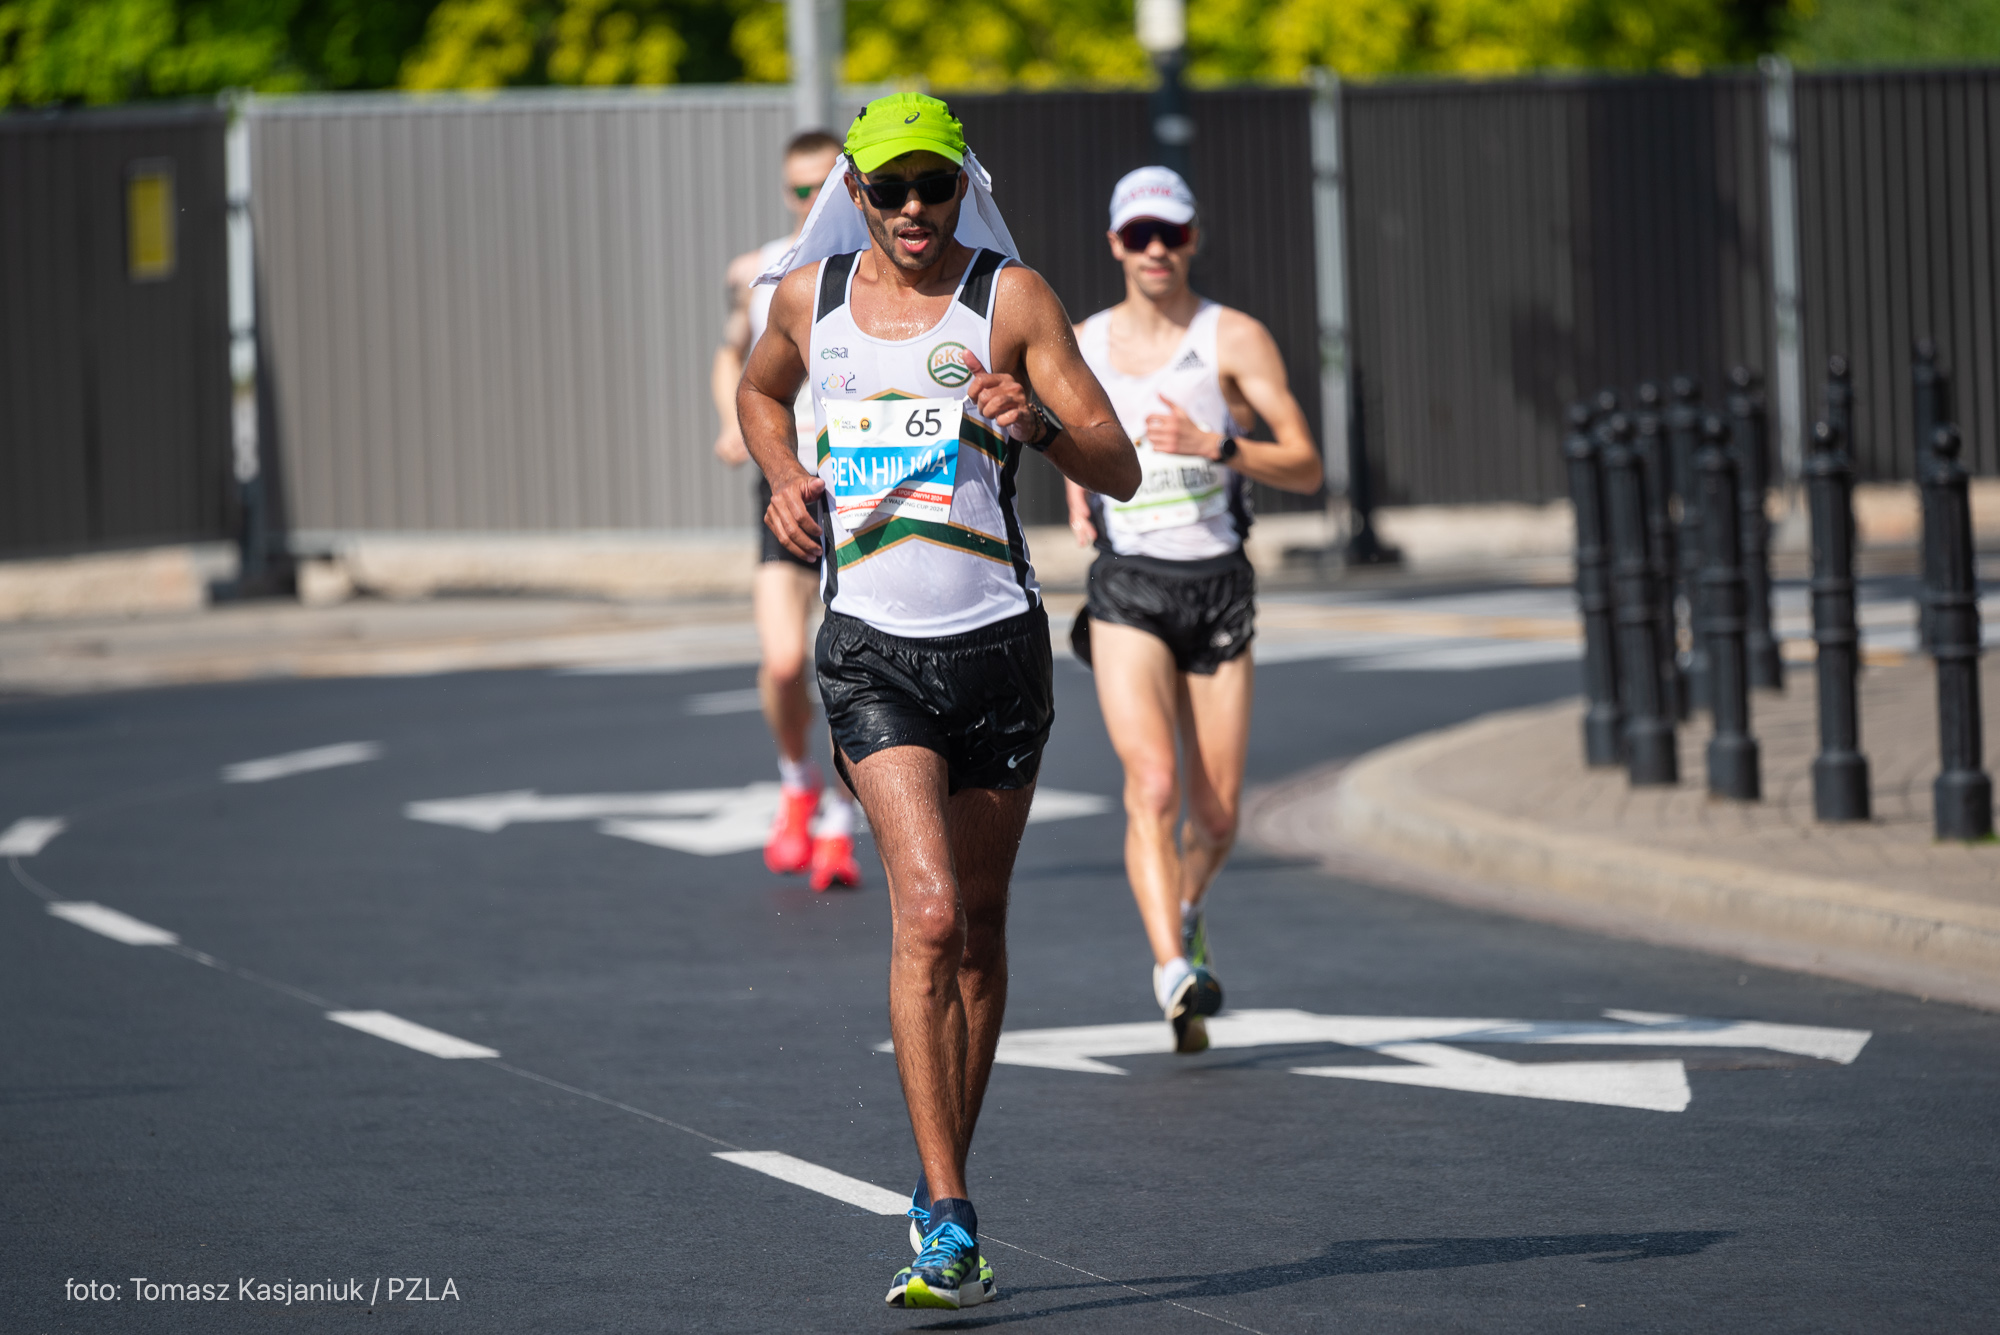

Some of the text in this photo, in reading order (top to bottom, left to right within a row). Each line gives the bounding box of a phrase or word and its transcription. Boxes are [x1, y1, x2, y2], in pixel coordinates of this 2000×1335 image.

[934, 348, 966, 367] RKS
[905, 408, 942, 437] 65
[831, 456, 866, 486] BEN
